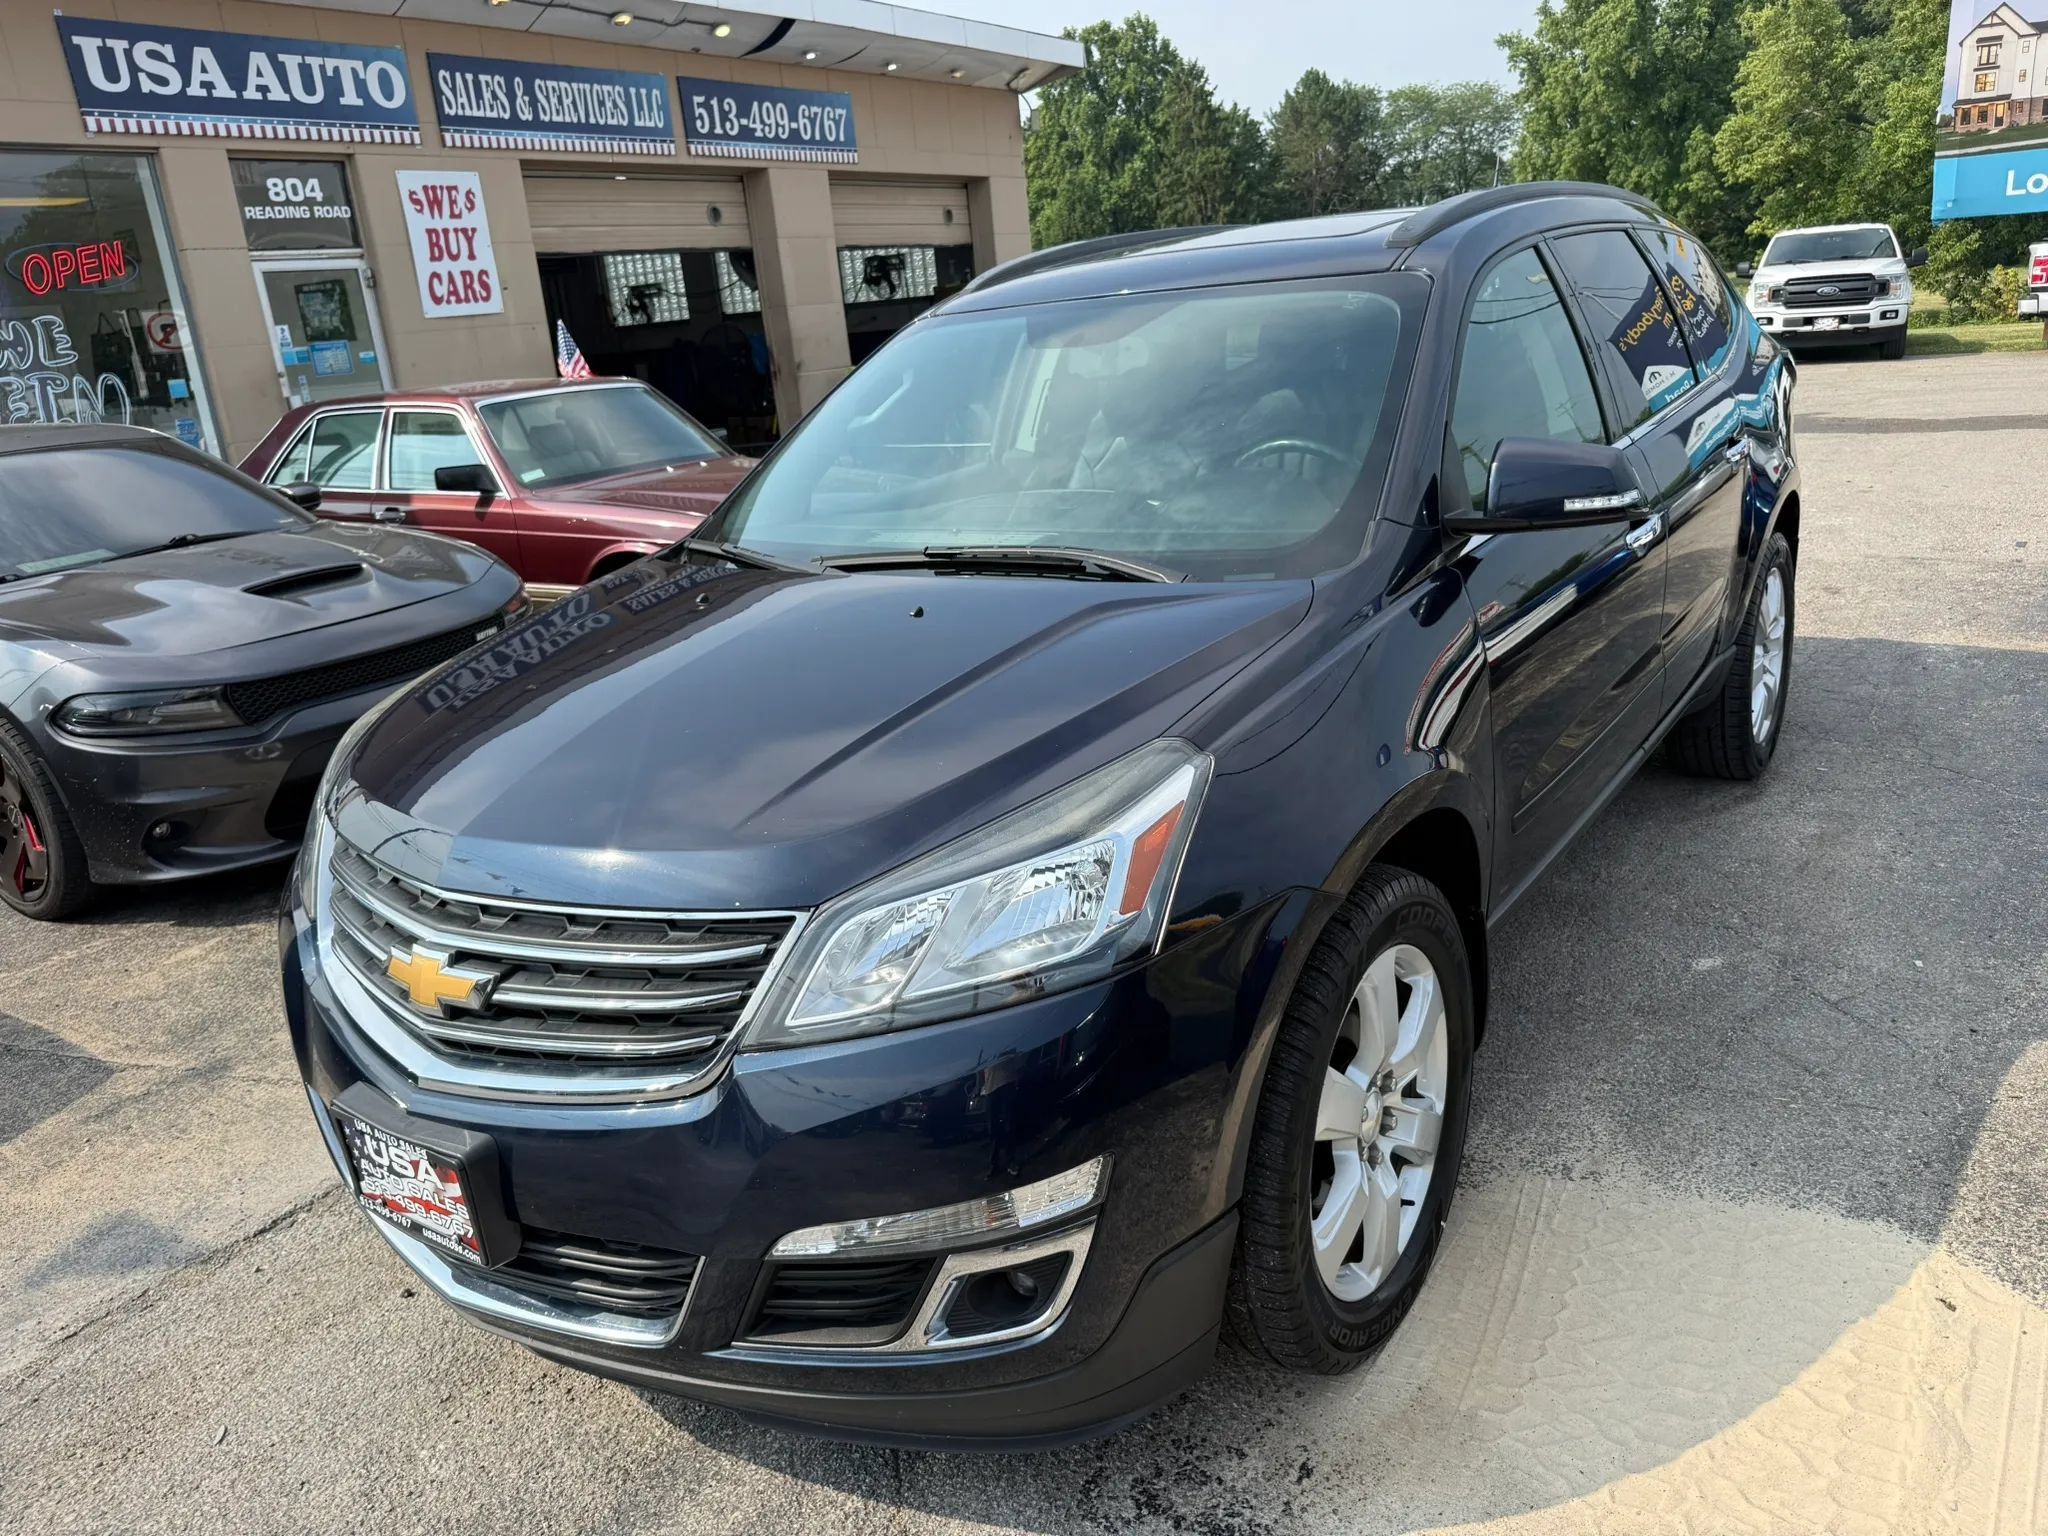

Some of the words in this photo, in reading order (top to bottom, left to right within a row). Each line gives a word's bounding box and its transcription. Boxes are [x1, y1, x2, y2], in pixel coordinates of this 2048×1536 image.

[71, 35, 236, 100] USA
[243, 51, 407, 109] AUTO
[438, 69, 511, 119] SALES
[514, 76, 534, 121] &
[535, 79, 628, 127] SERVICES
[629, 86, 665, 129] LLC
[693, 96, 847, 142] 513-499-6767
[245, 206, 310, 219] READING
[314, 206, 351, 219] ROAD
[266, 177, 323, 202] 804
[425, 227, 477, 262] BUY
[22, 240, 126, 296] OPEN
[428, 269, 492, 306] CARS
[354, 1119, 373, 1136] USA
[374, 1128, 398, 1147] AUTO
[399, 1139, 428, 1160] SALES
[364, 1133, 445, 1191] USA
[361, 1158, 404, 1191] AUTO
[408, 1181, 470, 1220] SALES
